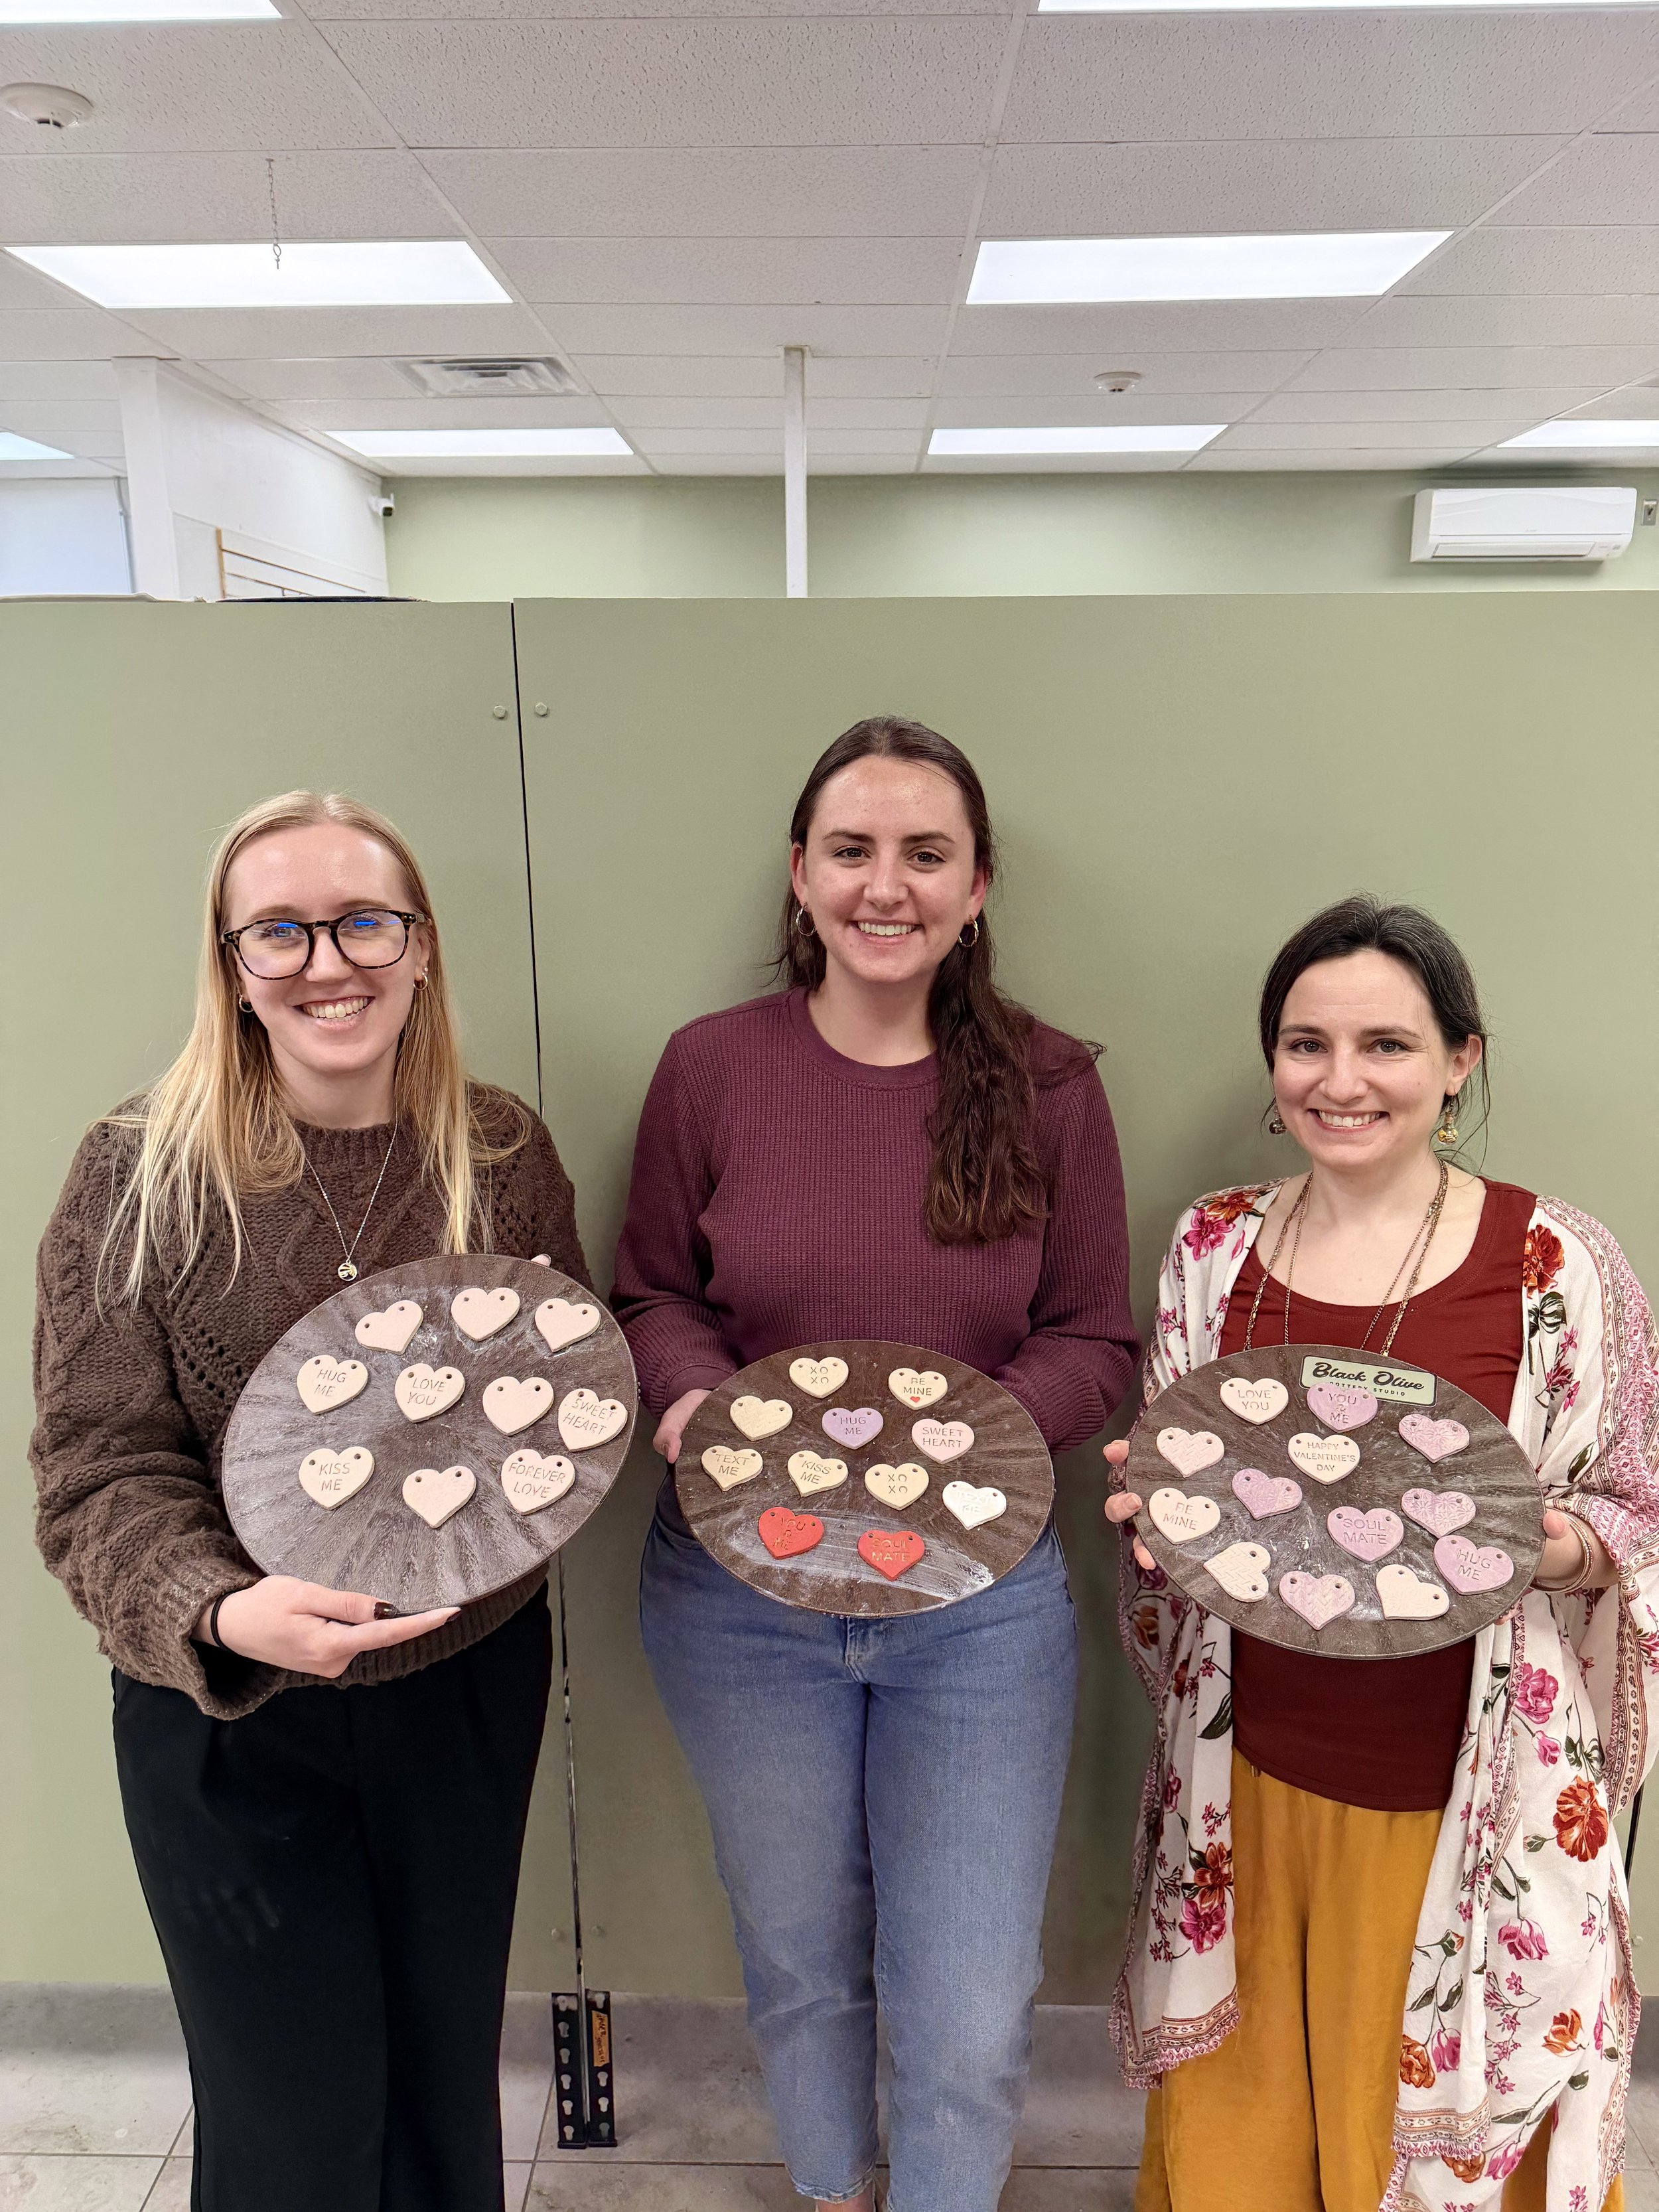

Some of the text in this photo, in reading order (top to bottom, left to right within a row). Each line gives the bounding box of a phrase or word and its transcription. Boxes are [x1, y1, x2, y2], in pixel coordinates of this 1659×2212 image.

[317, 1369, 346, 1383] HUG
[910, 1377, 926, 1386] BE
[1312, 1362, 1425, 1390] Black Olive
[315, 1384, 336, 1397] ME
[412, 1378, 446, 1392] LOVE
[903, 1386, 932, 1396] MINE
[1238, 1390, 1271, 1399] LOVE
[1373, 1388, 1406, 1396] STUDIO
[407, 1392, 437, 1406] YOU
[1329, 1393, 1357, 1405] YOU
[571, 1398, 617, 1420] SWEET
[1242, 1401, 1269, 1410] YOU
[563, 1412, 607, 1436] HEART
[840, 1416, 866, 1426] HUG
[1330, 1412, 1350, 1424] ME
[922, 1427, 964, 1438] SWEET
[922, 1438, 963, 1448] HEART
[1307, 1441, 1338, 1450] HAPPY
[716, 1453, 750, 1465] TEXT
[1294, 1451, 1356, 1462] VALENTINE'S
[319, 1463, 350, 1476] KISS
[508, 1462, 566, 1484] FOREVER
[718, 1465, 739, 1476] ME
[802, 1460, 831, 1475] KISS
[800, 1471, 822, 1485] ME
[321, 1479, 343, 1491] ME
[514, 1481, 551, 1499] LOVE
[1175, 1502, 1193, 1514] BE
[1163, 1513, 1198, 1530] MINE
[1343, 1518, 1386, 1531] SOUL
[872, 1538, 906, 1548] SOUL
[1343, 1532, 1388, 1544] MATE
[871, 1551, 911, 1562] MATE
[1457, 1549, 1492, 1570] HUG
[1458, 1565, 1482, 1580] ME
